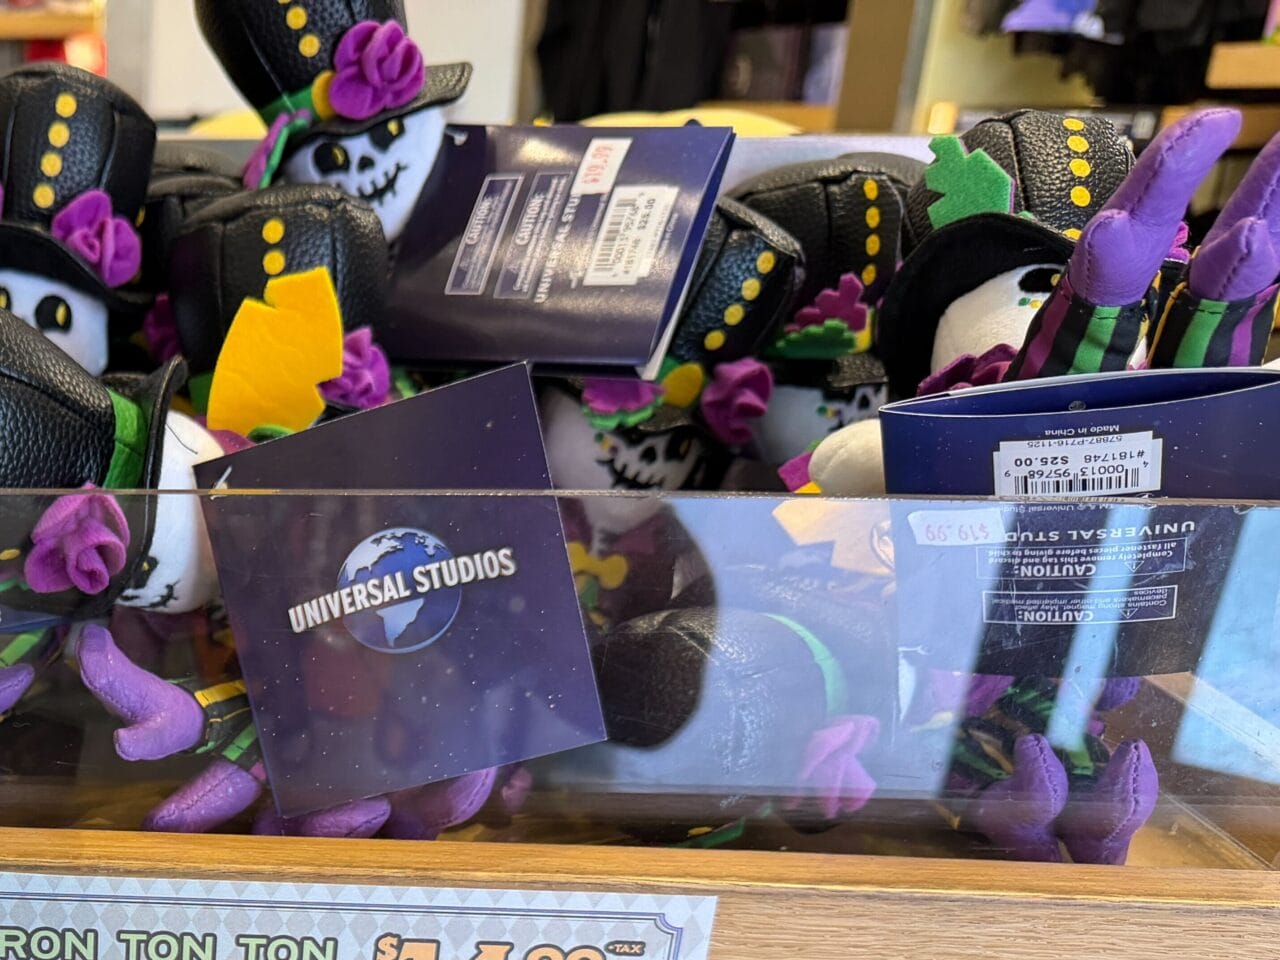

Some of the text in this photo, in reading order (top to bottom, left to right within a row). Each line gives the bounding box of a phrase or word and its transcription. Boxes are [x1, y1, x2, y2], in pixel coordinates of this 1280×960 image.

[1044, 424, 1120, 437] Made in China
[1014, 450, 1145, 467] #181748 $25.00
[1028, 468, 1070, 479] 95768
[1080, 464, 1124, 477] 00013
[925, 523, 989, 540] $19.99
[1067, 520, 1195, 541] UNIVERSAL
[1163, 541, 1177, 550] all
[1024, 548, 1053, 556] giving
[1118, 550, 1173, 560] Completely
[1023, 557, 1041, 565] and
[1041, 555, 1060, 564] tag
[1061, 556, 1080, 565] this
[1080, 554, 1116, 562] remove
[1014, 563, 1097, 577] CAUTION:
[288, 547, 517, 634] UNIVERSAL STUDIOS
[1017, 610, 1094, 622] CAUTION:
